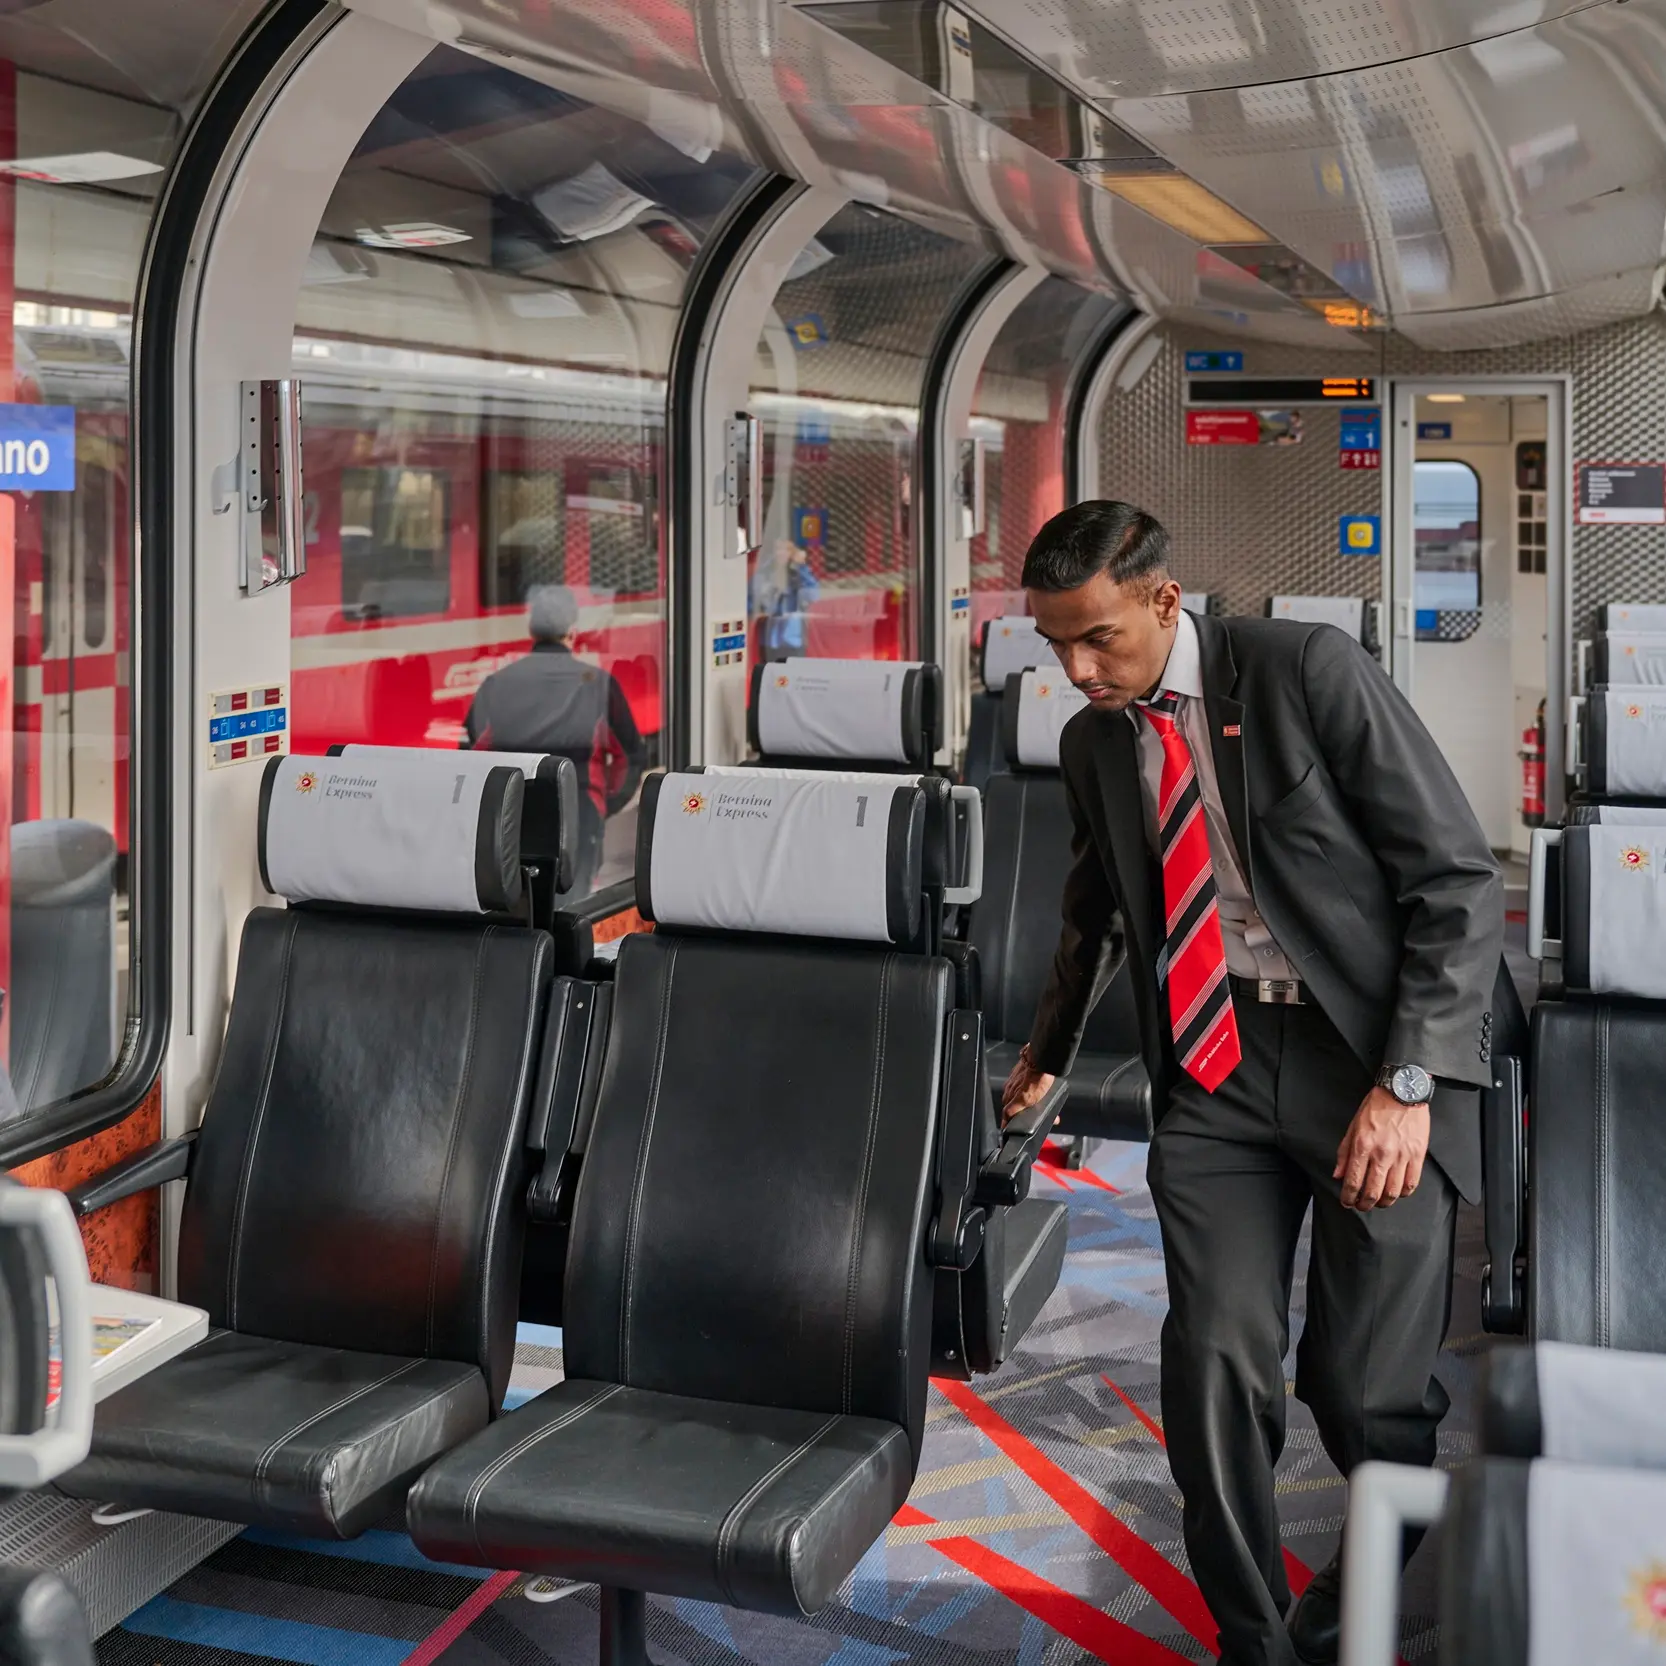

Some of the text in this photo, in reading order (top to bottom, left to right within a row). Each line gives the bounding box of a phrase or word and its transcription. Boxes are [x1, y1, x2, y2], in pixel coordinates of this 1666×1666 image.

[1365, 431, 1375, 449] 1
[328, 774, 378, 788] Bernina
[326, 786, 374, 800] Express
[452, 774, 467, 804] 1
[718, 793, 773, 807] Bernina
[716, 807, 769, 820] Express
[855, 795, 869, 828] 1
